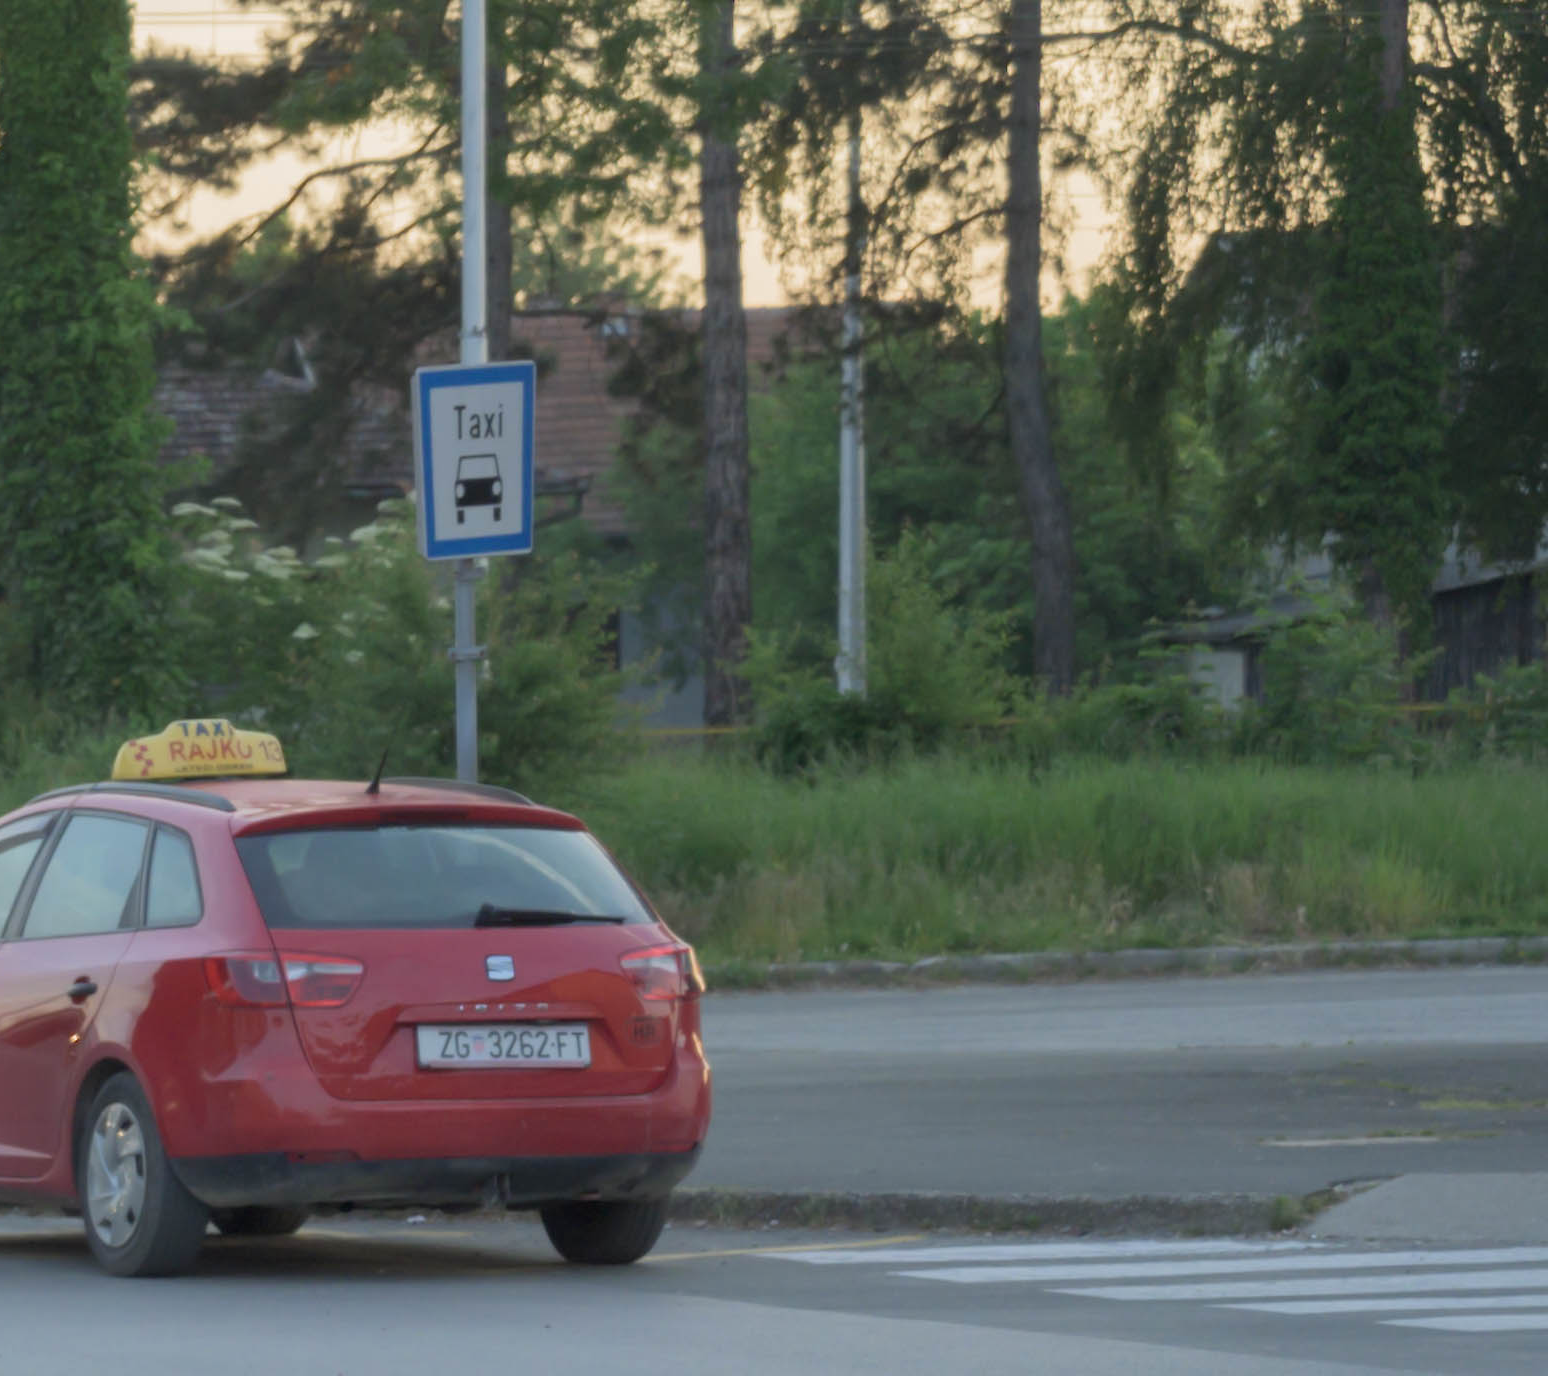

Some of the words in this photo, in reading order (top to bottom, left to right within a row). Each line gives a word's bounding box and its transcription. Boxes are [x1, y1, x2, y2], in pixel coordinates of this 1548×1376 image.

[453, 403, 504, 440] Taxi
[177, 722, 235, 737] TAXI
[438, 1031, 471, 1059] ZG
